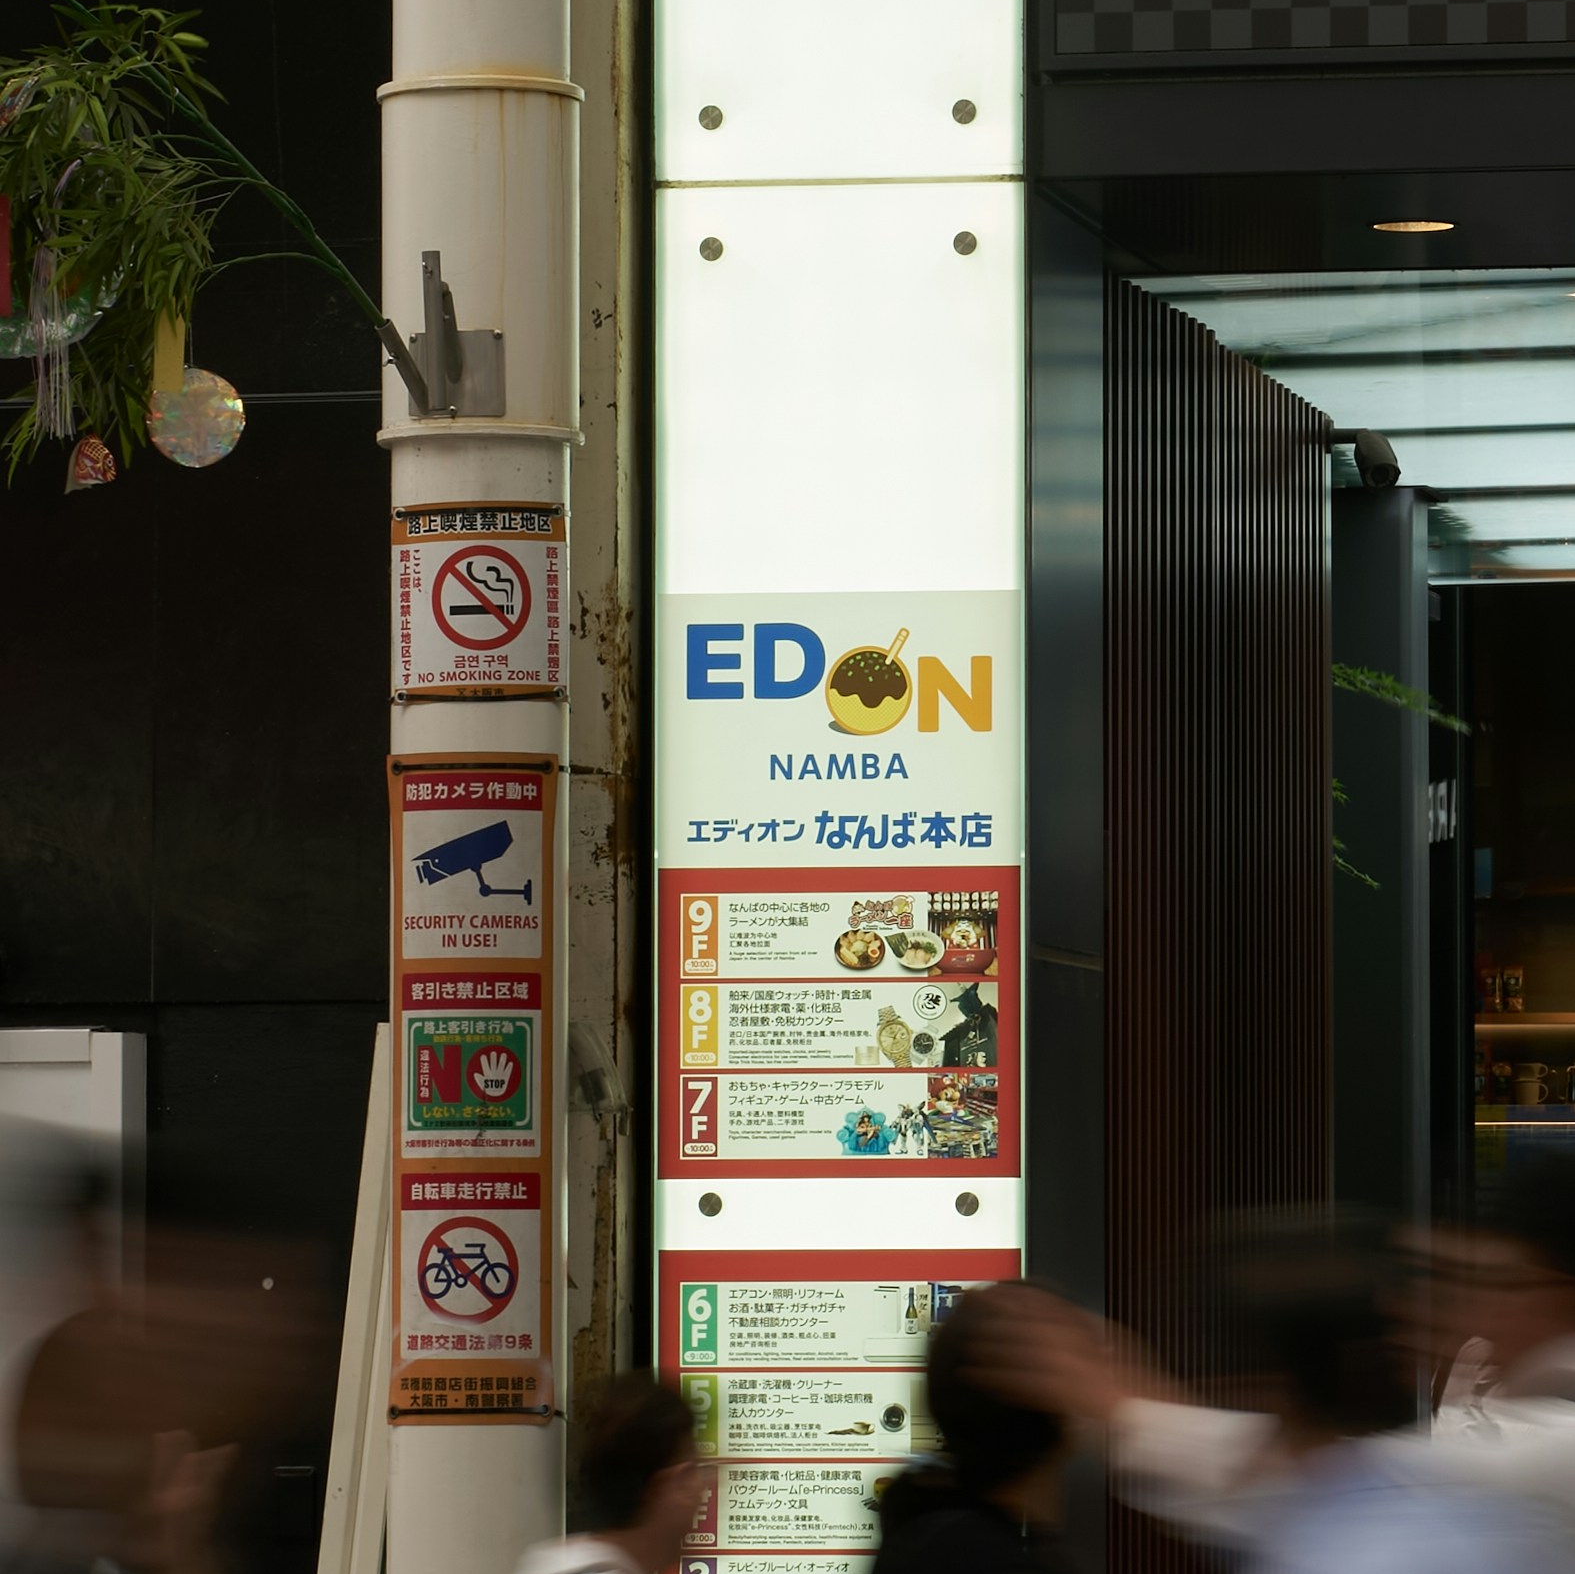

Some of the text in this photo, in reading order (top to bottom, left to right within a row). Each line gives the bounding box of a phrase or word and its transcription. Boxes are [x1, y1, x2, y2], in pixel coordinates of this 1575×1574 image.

[418, 670, 541, 683] NO SMOKING ZONE
[770, 753, 909, 780] NAMBA
[406, 782, 537, 801] 防犯カメラ作動中
[687, 810, 992, 849] エディオン なんば本店
[404, 914, 539, 930] SECURITY CAMERAS
[442, 934, 498, 948] IN USE!
[411, 982, 529, 1000] 客引き禁止区域
[484, 1079, 505, 1089] STOP
[411, 1183, 527, 1201] 自転車走行禁止
